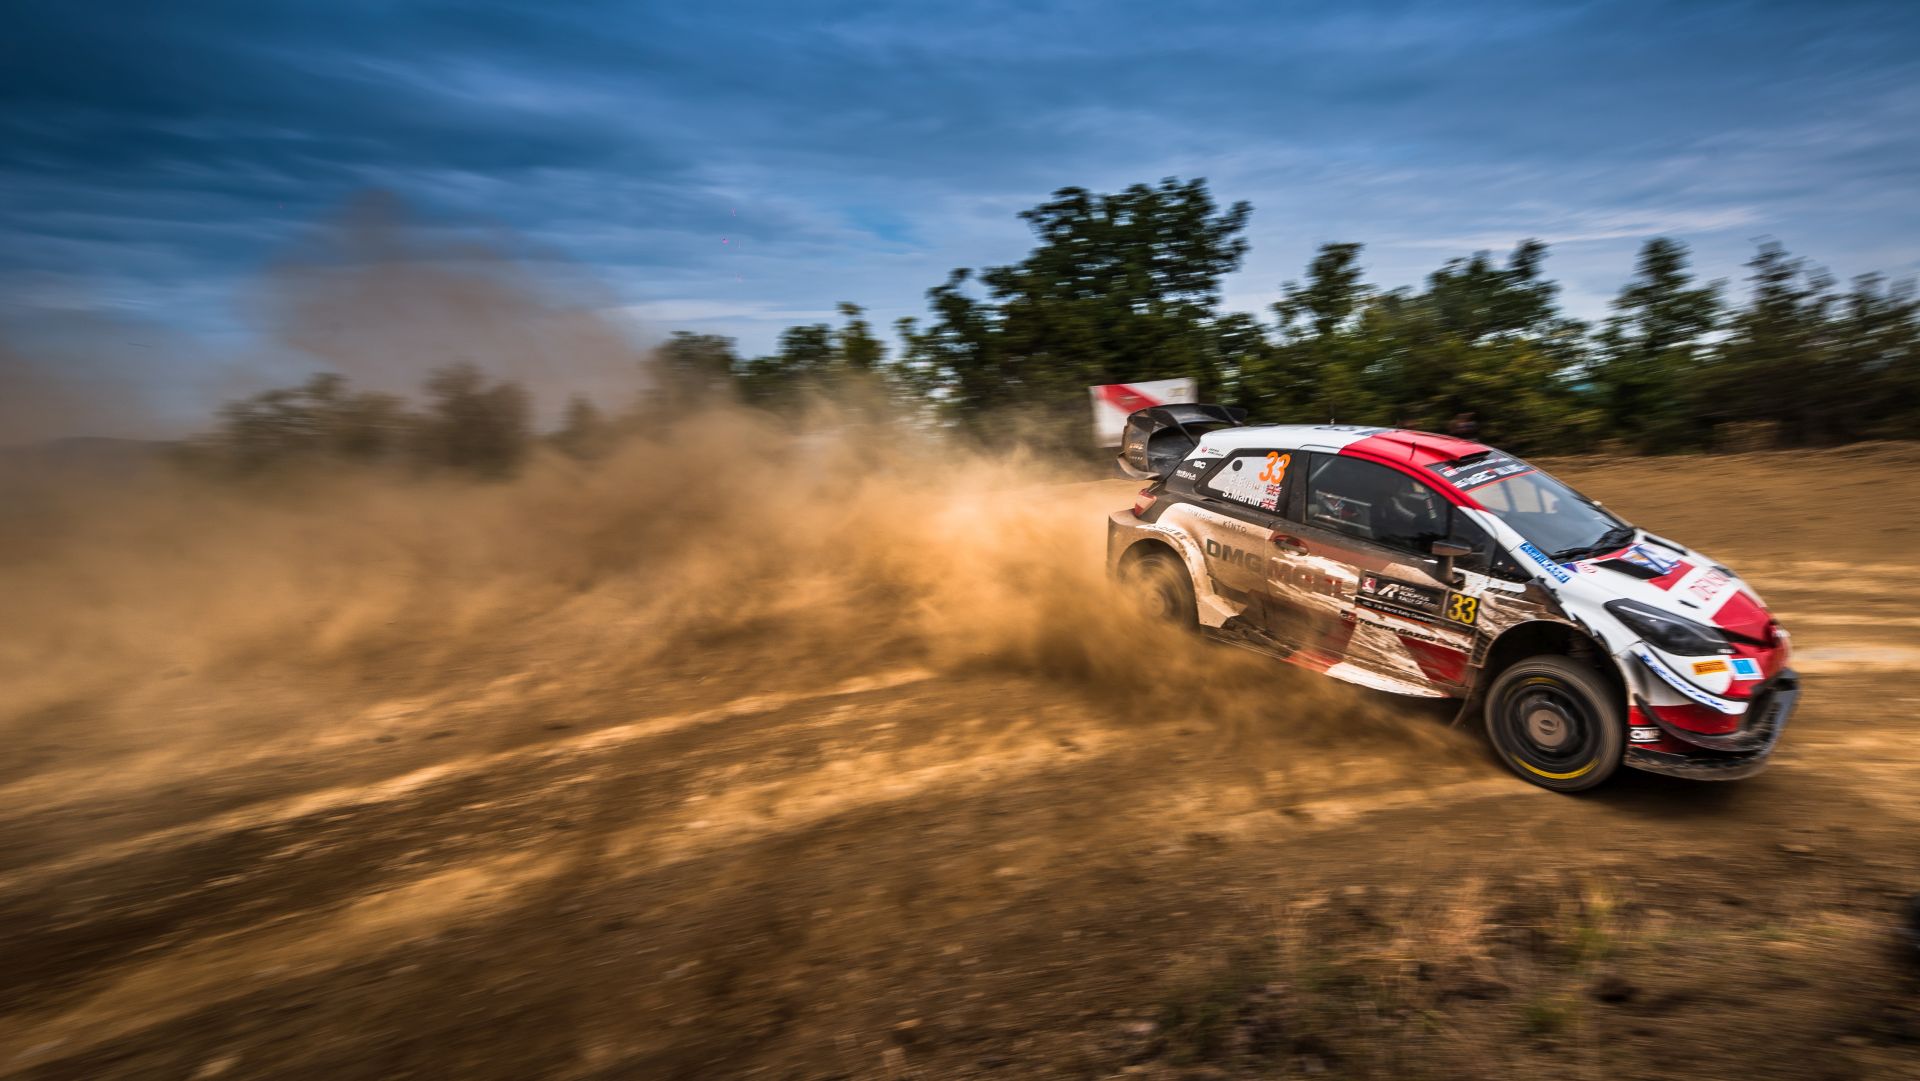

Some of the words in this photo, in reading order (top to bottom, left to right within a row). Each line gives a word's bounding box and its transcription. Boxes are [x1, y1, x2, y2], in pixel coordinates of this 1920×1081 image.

[1259, 451, 1291, 485] 33
[1207, 538, 1264, 573] DMG
[1448, 593, 1478, 625] 33
[1359, 617, 1397, 633] TOYOTA
[1398, 627, 1436, 642] GAZOO
